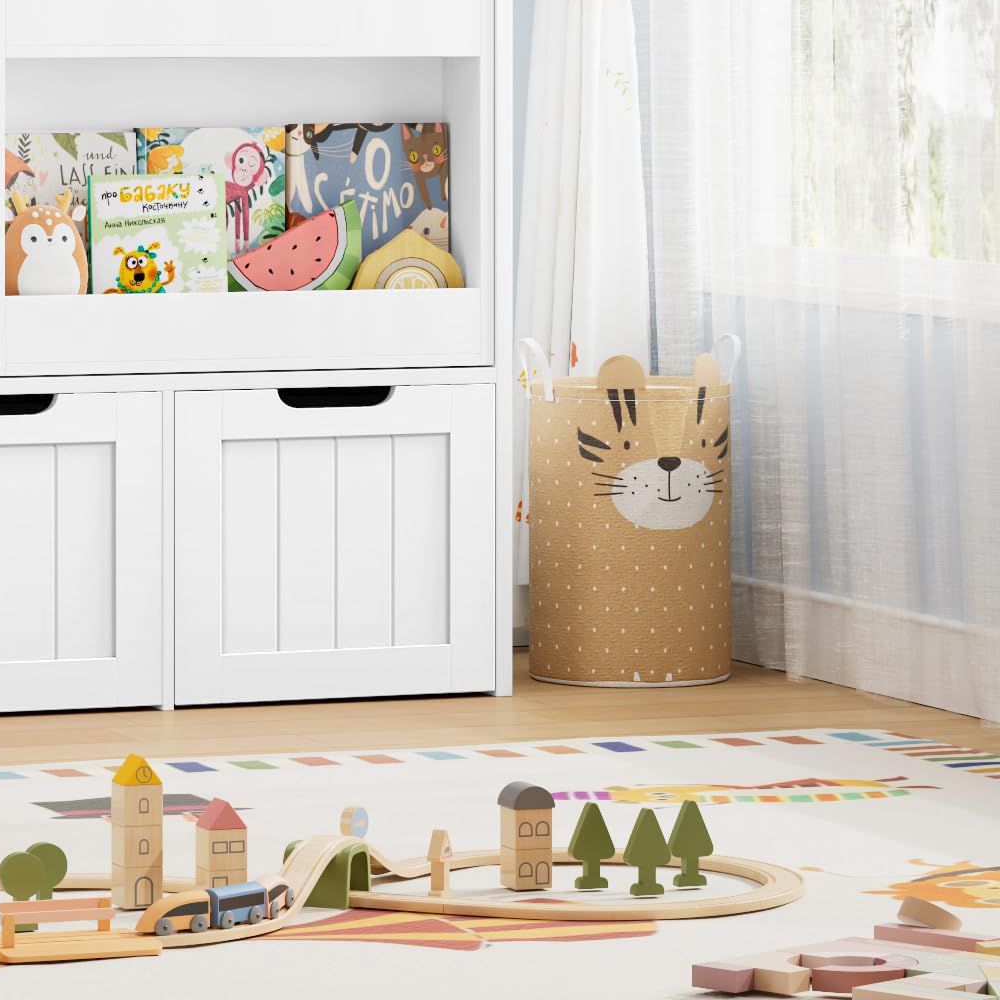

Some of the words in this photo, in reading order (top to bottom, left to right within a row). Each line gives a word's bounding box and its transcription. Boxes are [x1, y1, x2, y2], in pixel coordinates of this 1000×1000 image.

[84, 146, 117, 161] und
[364, 137, 391, 190] O
[104, 221, 122, 229] Анна
